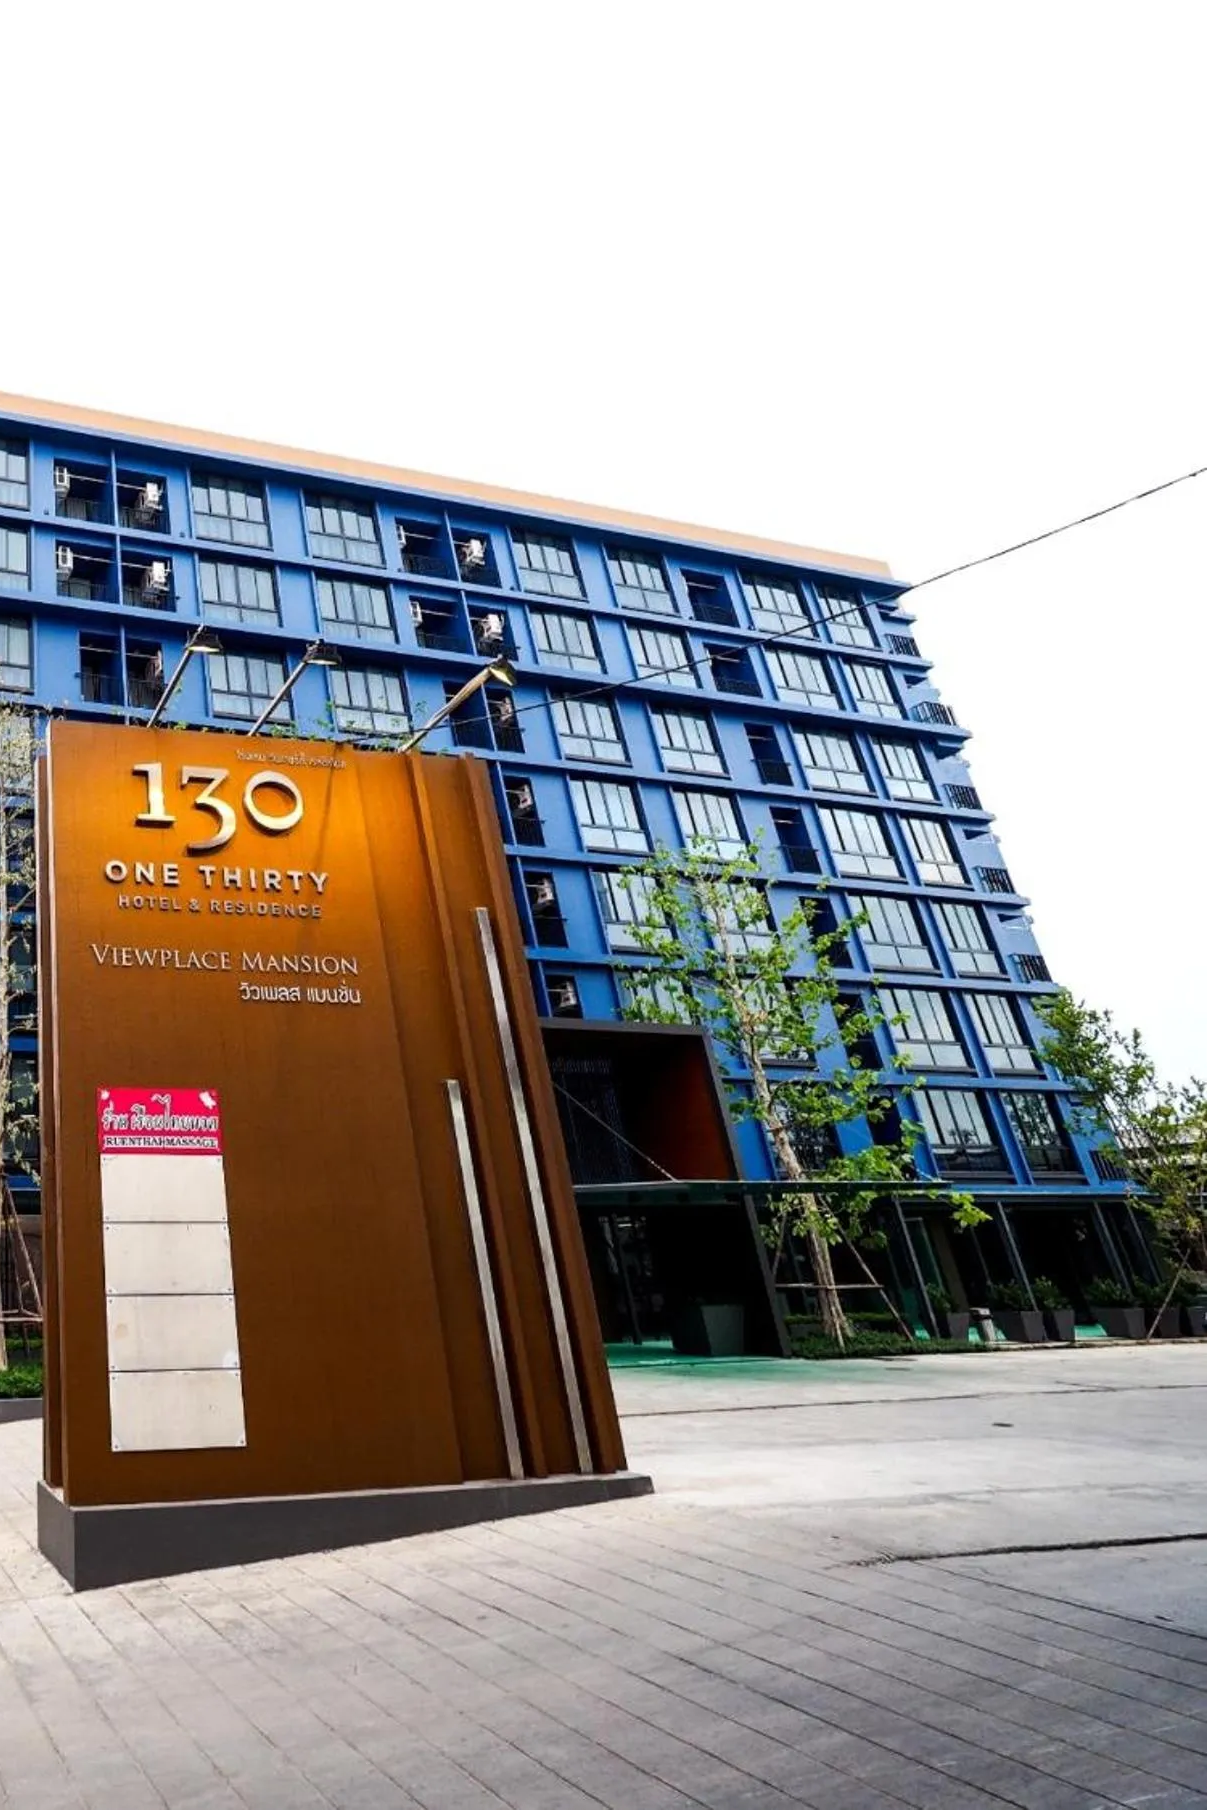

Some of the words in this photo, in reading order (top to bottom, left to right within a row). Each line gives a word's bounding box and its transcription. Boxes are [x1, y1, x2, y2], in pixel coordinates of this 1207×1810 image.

[131, 761, 304, 855] 130
[105, 859, 180, 886] ONE
[198, 864, 329, 894] THIRTY
[118, 894, 181, 911] HOTEL
[189, 896, 200, 912] &
[210, 899, 322, 918] RESIDENCE
[238, 981, 301, 1001] วิวเพลส
